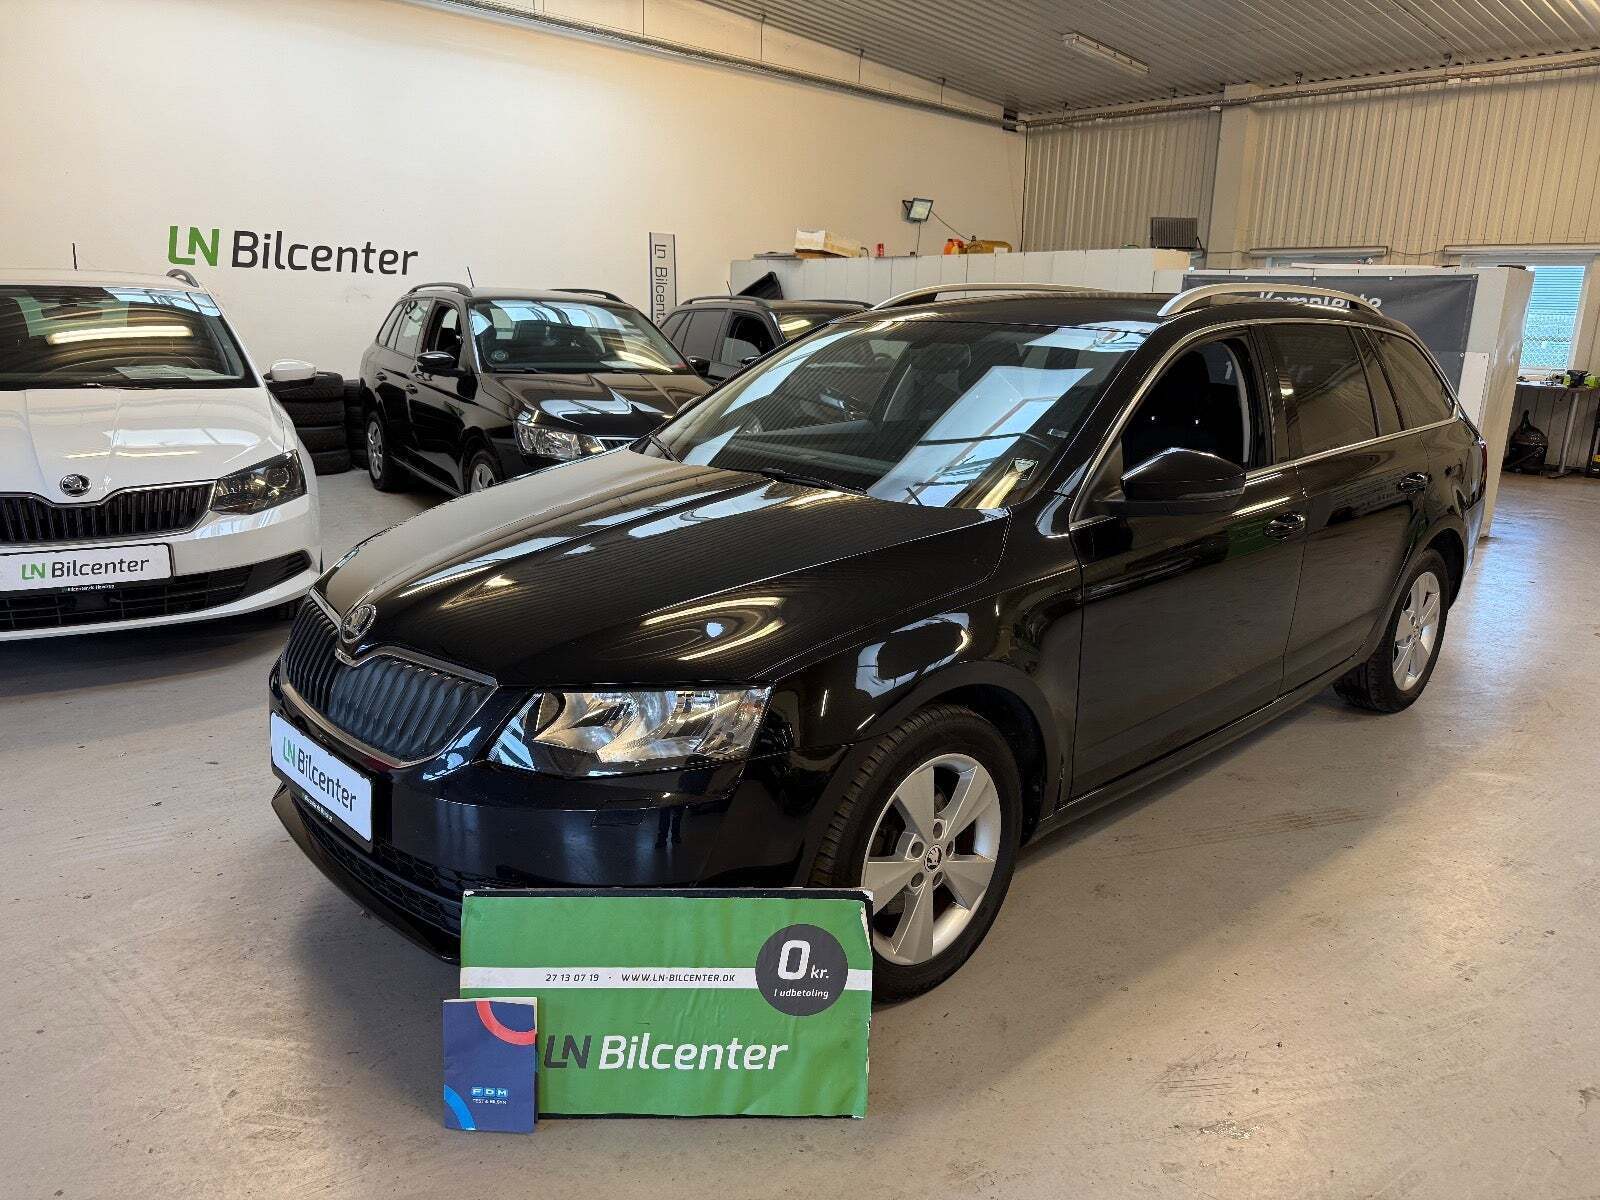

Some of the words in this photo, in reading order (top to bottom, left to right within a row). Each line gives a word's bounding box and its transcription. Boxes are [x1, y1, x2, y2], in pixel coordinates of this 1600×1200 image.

[167, 225, 220, 267] LN
[231, 230, 419, 276] Bilcenter
[655, 244, 667, 258] Ln
[21, 562, 46, 581] LN
[51, 558, 150, 579] Bilcenter
[282, 735, 296, 768] LN
[297, 748, 357, 812] Bilcenter
[777, 939, 811, 980] 0
[810, 965, 830, 980] kr.
[545, 973, 559, 983] 27
[560, 973, 571, 983] 13
[573, 973, 587, 983] 07
[588, 973, 600, 983] 19
[621, 973, 736, 983] WWW.LN-BILCENTER.DK
[779, 988, 829, 1000] udbetaling
[543, 1034, 593, 1069] LN
[598, 1032, 789, 1071] Bilcenter
[472, 1088, 508, 1097] FDM
